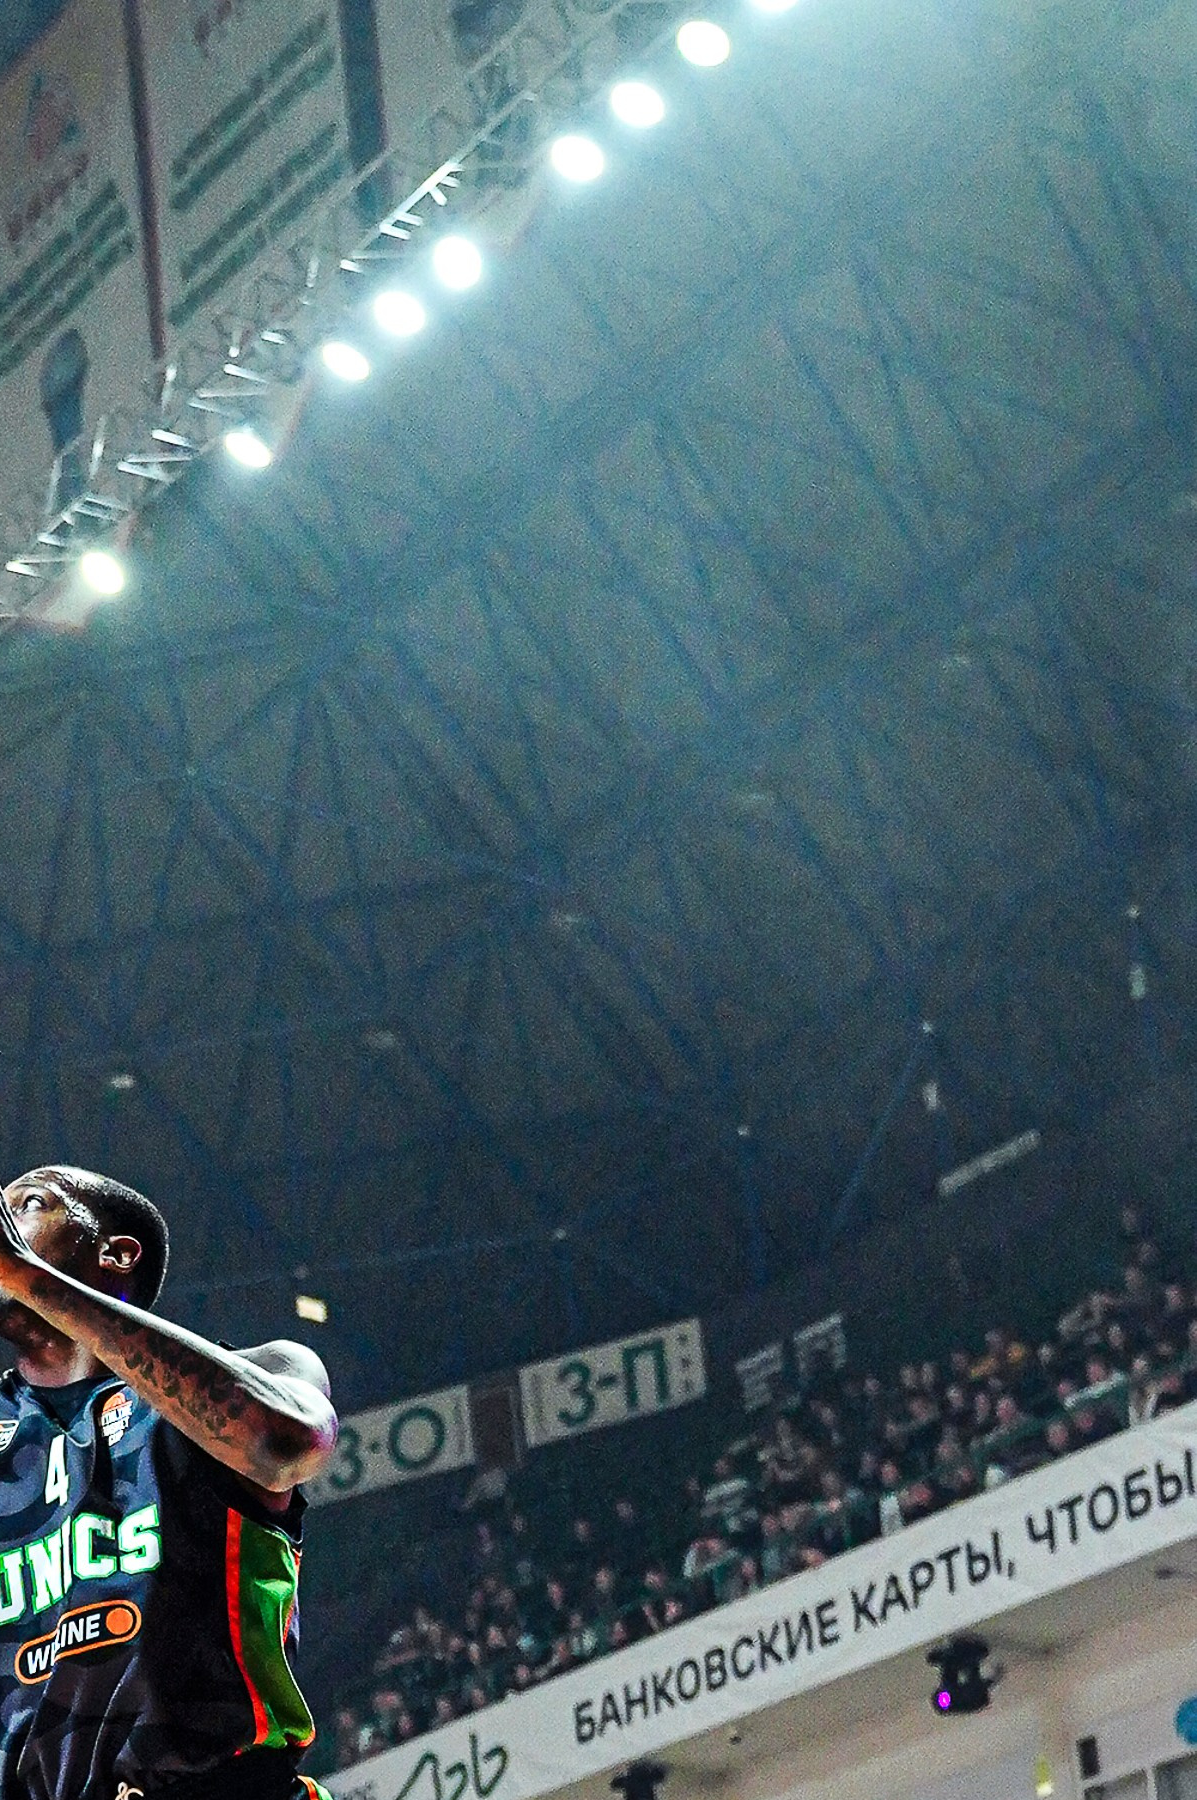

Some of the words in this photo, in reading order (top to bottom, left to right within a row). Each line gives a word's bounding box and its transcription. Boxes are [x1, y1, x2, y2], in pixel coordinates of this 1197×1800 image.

[45, 1434, 70, 1507] 4
[573, 1599, 841, 1745] БАНКОВСКИЕ
[850, 1530, 1016, 1633] КАРТЫ,
[1025, 1449, 1197, 1555] ЧТОБЫ
